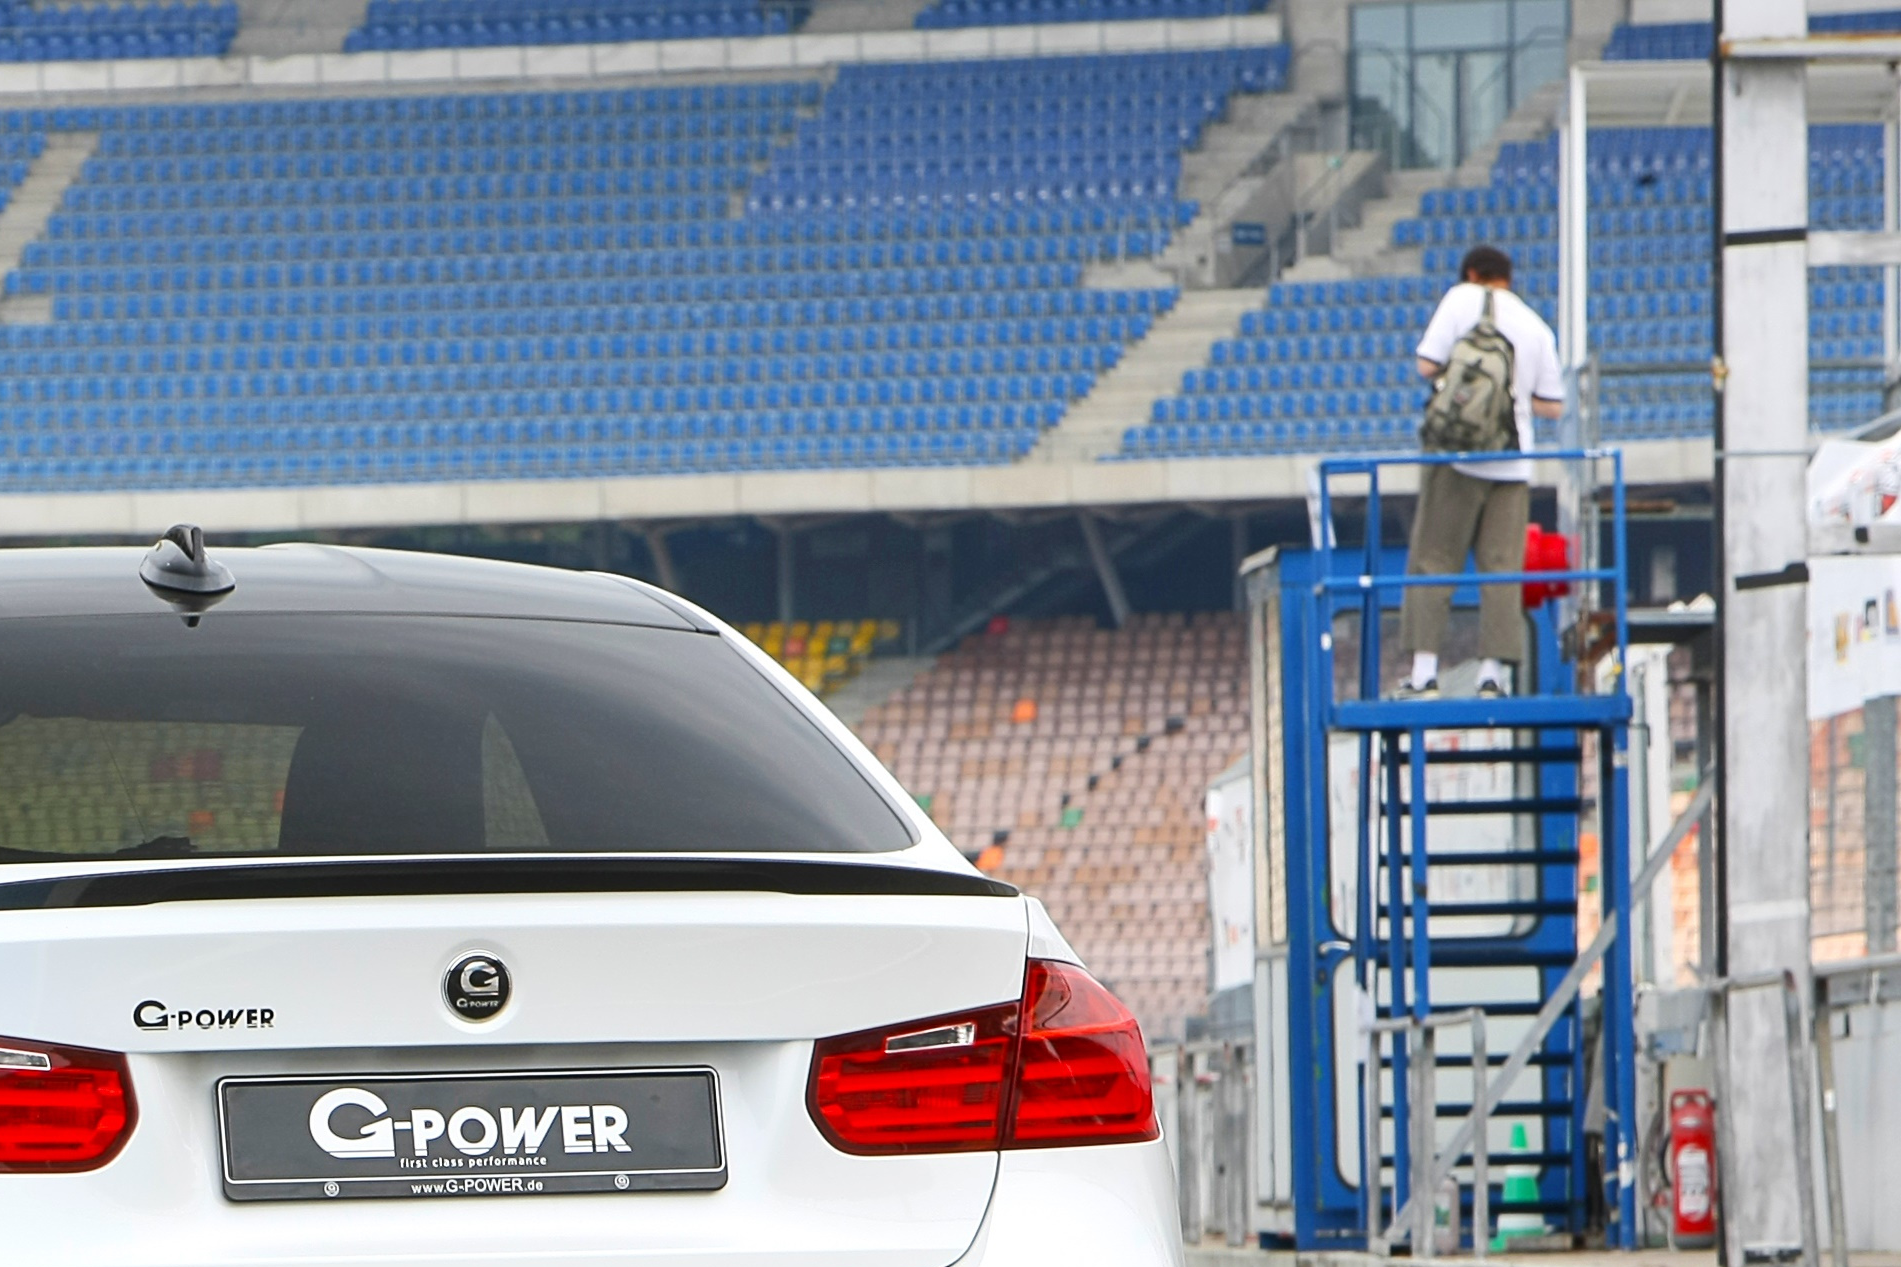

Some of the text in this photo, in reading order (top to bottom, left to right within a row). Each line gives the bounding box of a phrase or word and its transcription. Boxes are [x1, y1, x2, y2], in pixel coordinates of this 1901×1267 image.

[133, 999, 275, 1031] G-POWER
[308, 1087, 632, 1159] G-POWER
[400, 1156, 547, 1168] first class performance
[411, 1178, 544, 1194] www.G-POWER.de
